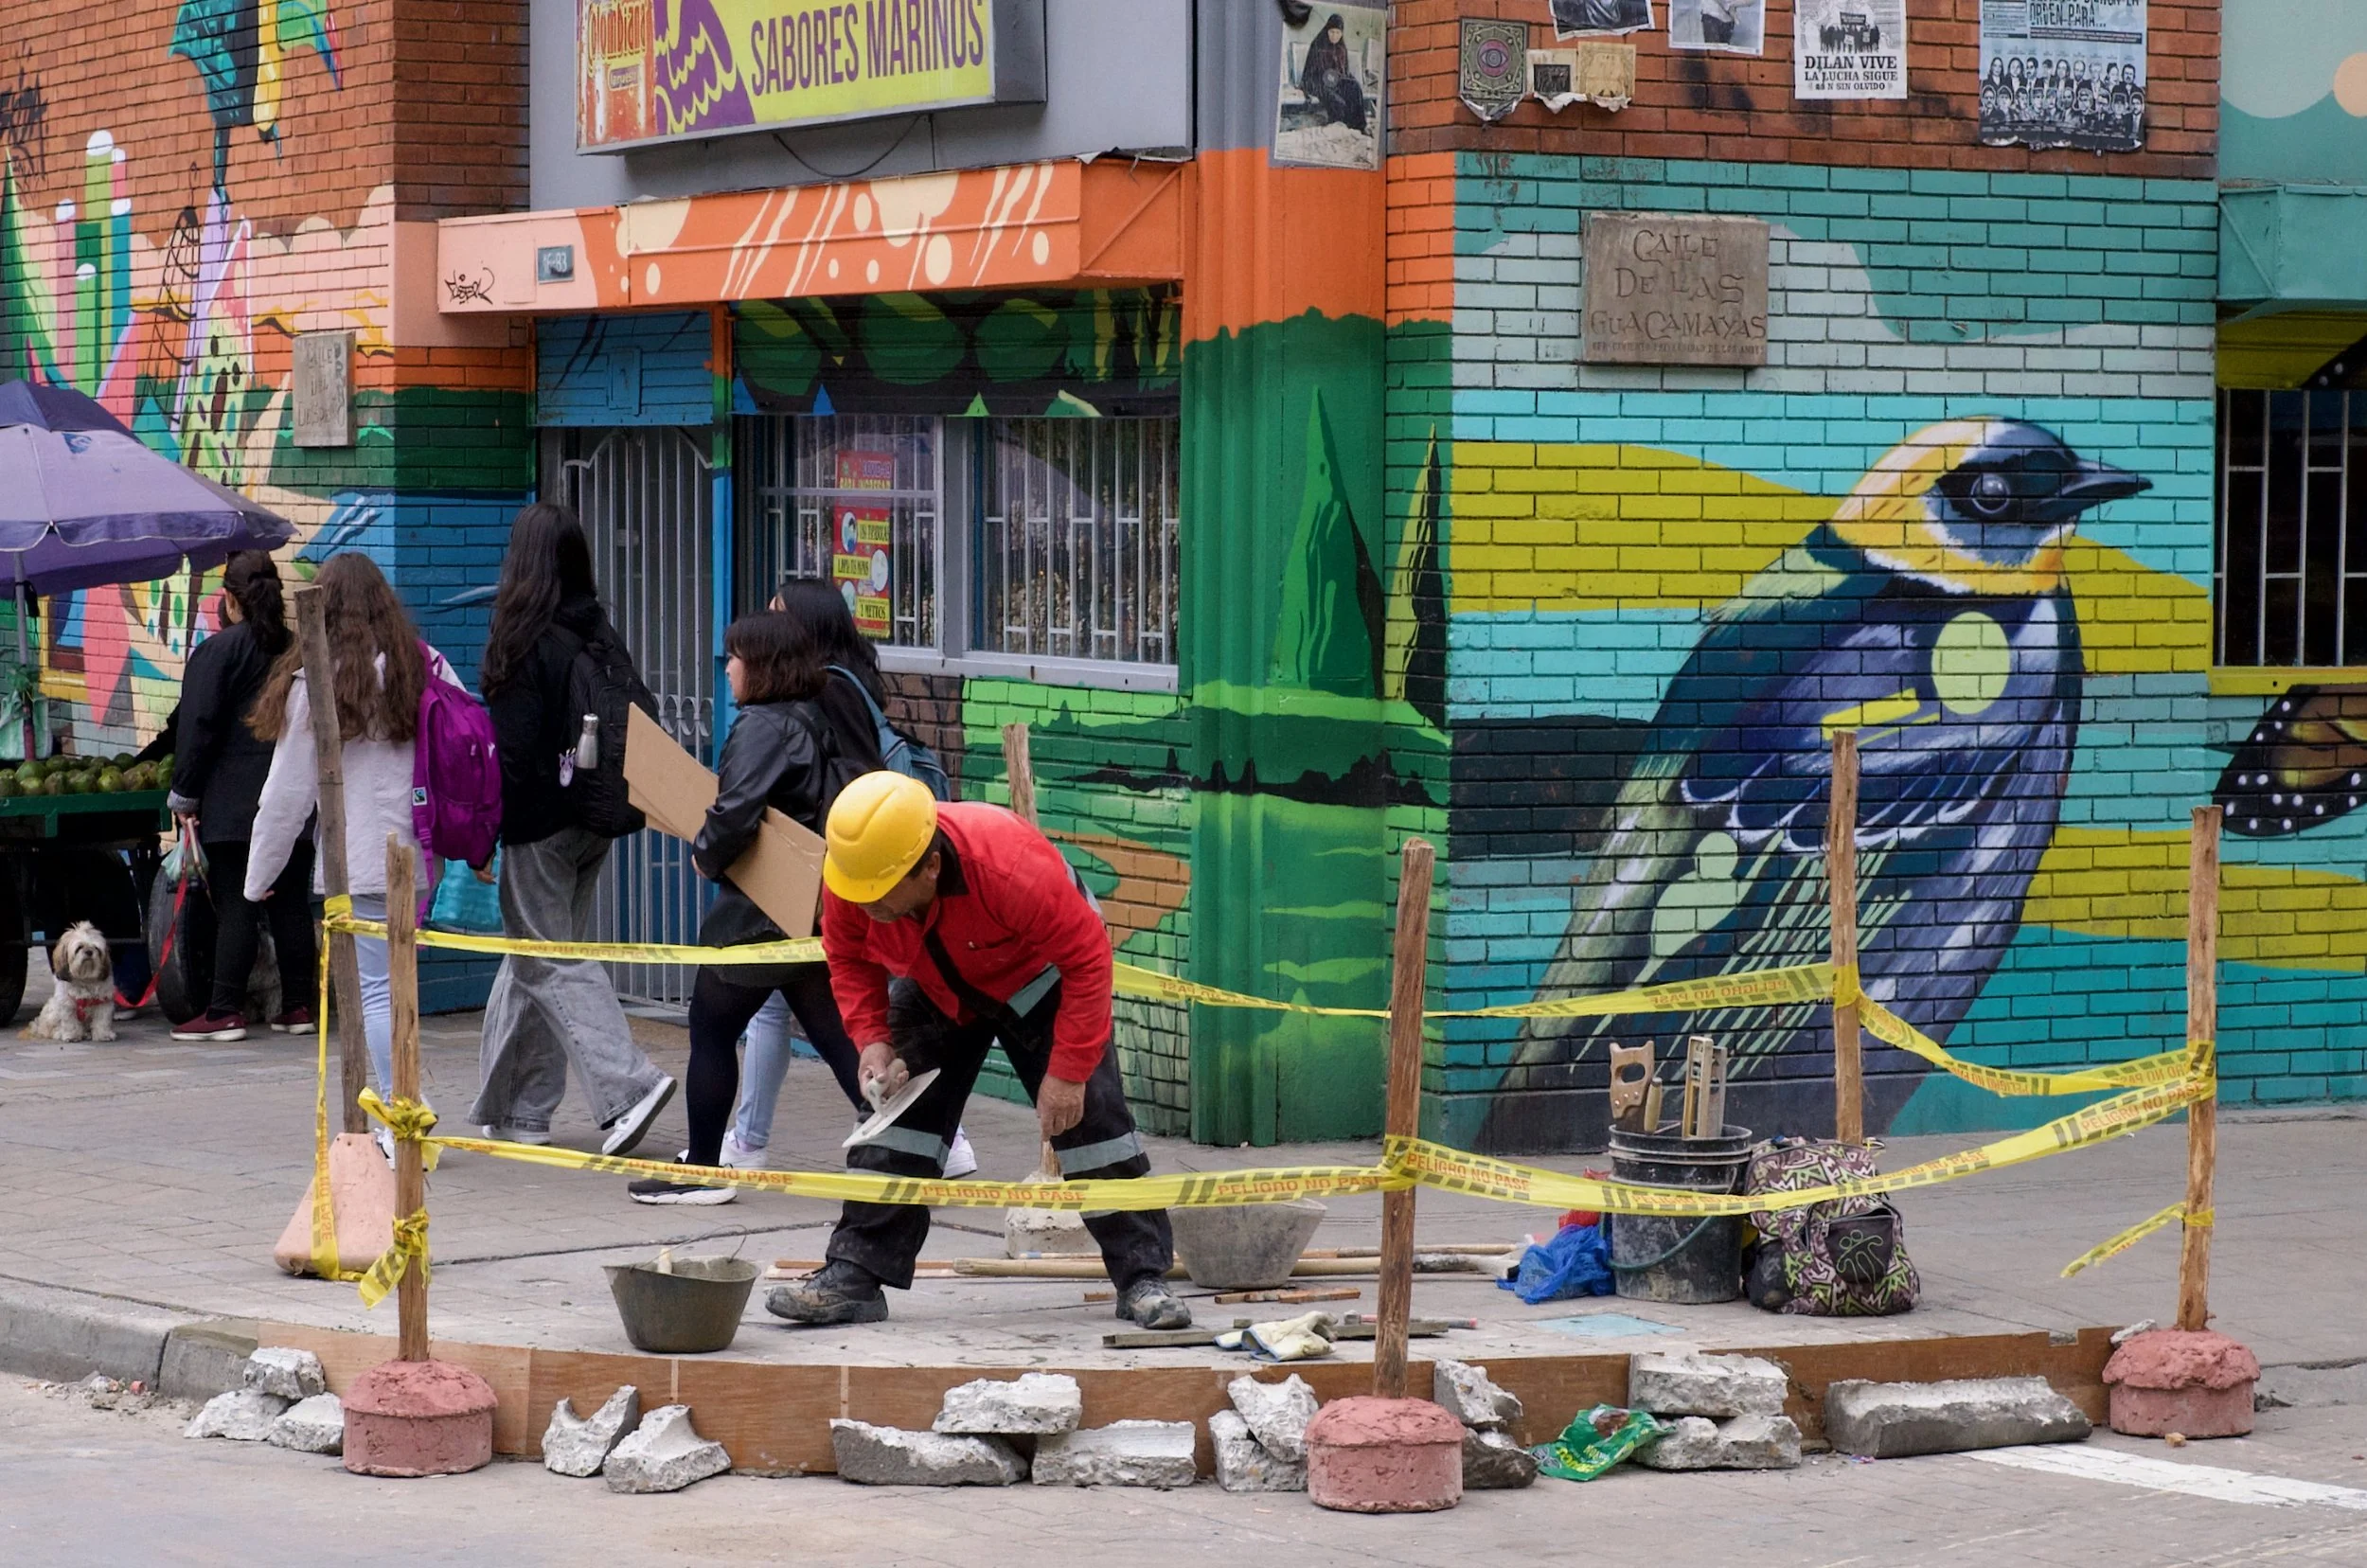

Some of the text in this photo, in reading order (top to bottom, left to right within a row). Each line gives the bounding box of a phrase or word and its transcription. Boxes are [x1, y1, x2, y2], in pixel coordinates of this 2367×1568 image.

[751, 0, 984, 97] SABORES MARINOS
[1805, 56, 1897, 70] DILAN VIVE
[1805, 71, 1898, 81] LA LUCHA SIGUE
[1837, 82, 1851, 91] SIN
[1853, 82, 1886, 91] OLVIDO
[1634, 230, 1718, 266] CALLE
[1614, 267, 1745, 304] DE LAS
[1591, 311, 1768, 341] GUACAMAYAS
[2082, 1105, 2140, 1131] PELIGRO
[2142, 1096, 2163, 1112] NO
[715, 1169, 740, 1181] NO
[746, 1170, 793, 1185] PASE
[1407, 1153, 1530, 1190] PELIGRO NO PASE
[922, 1185, 1086, 1202] PELIGRO NO PASE
[1218, 1180, 1299, 1195] PELIGRO
[1306, 1179, 1331, 1190] NO
